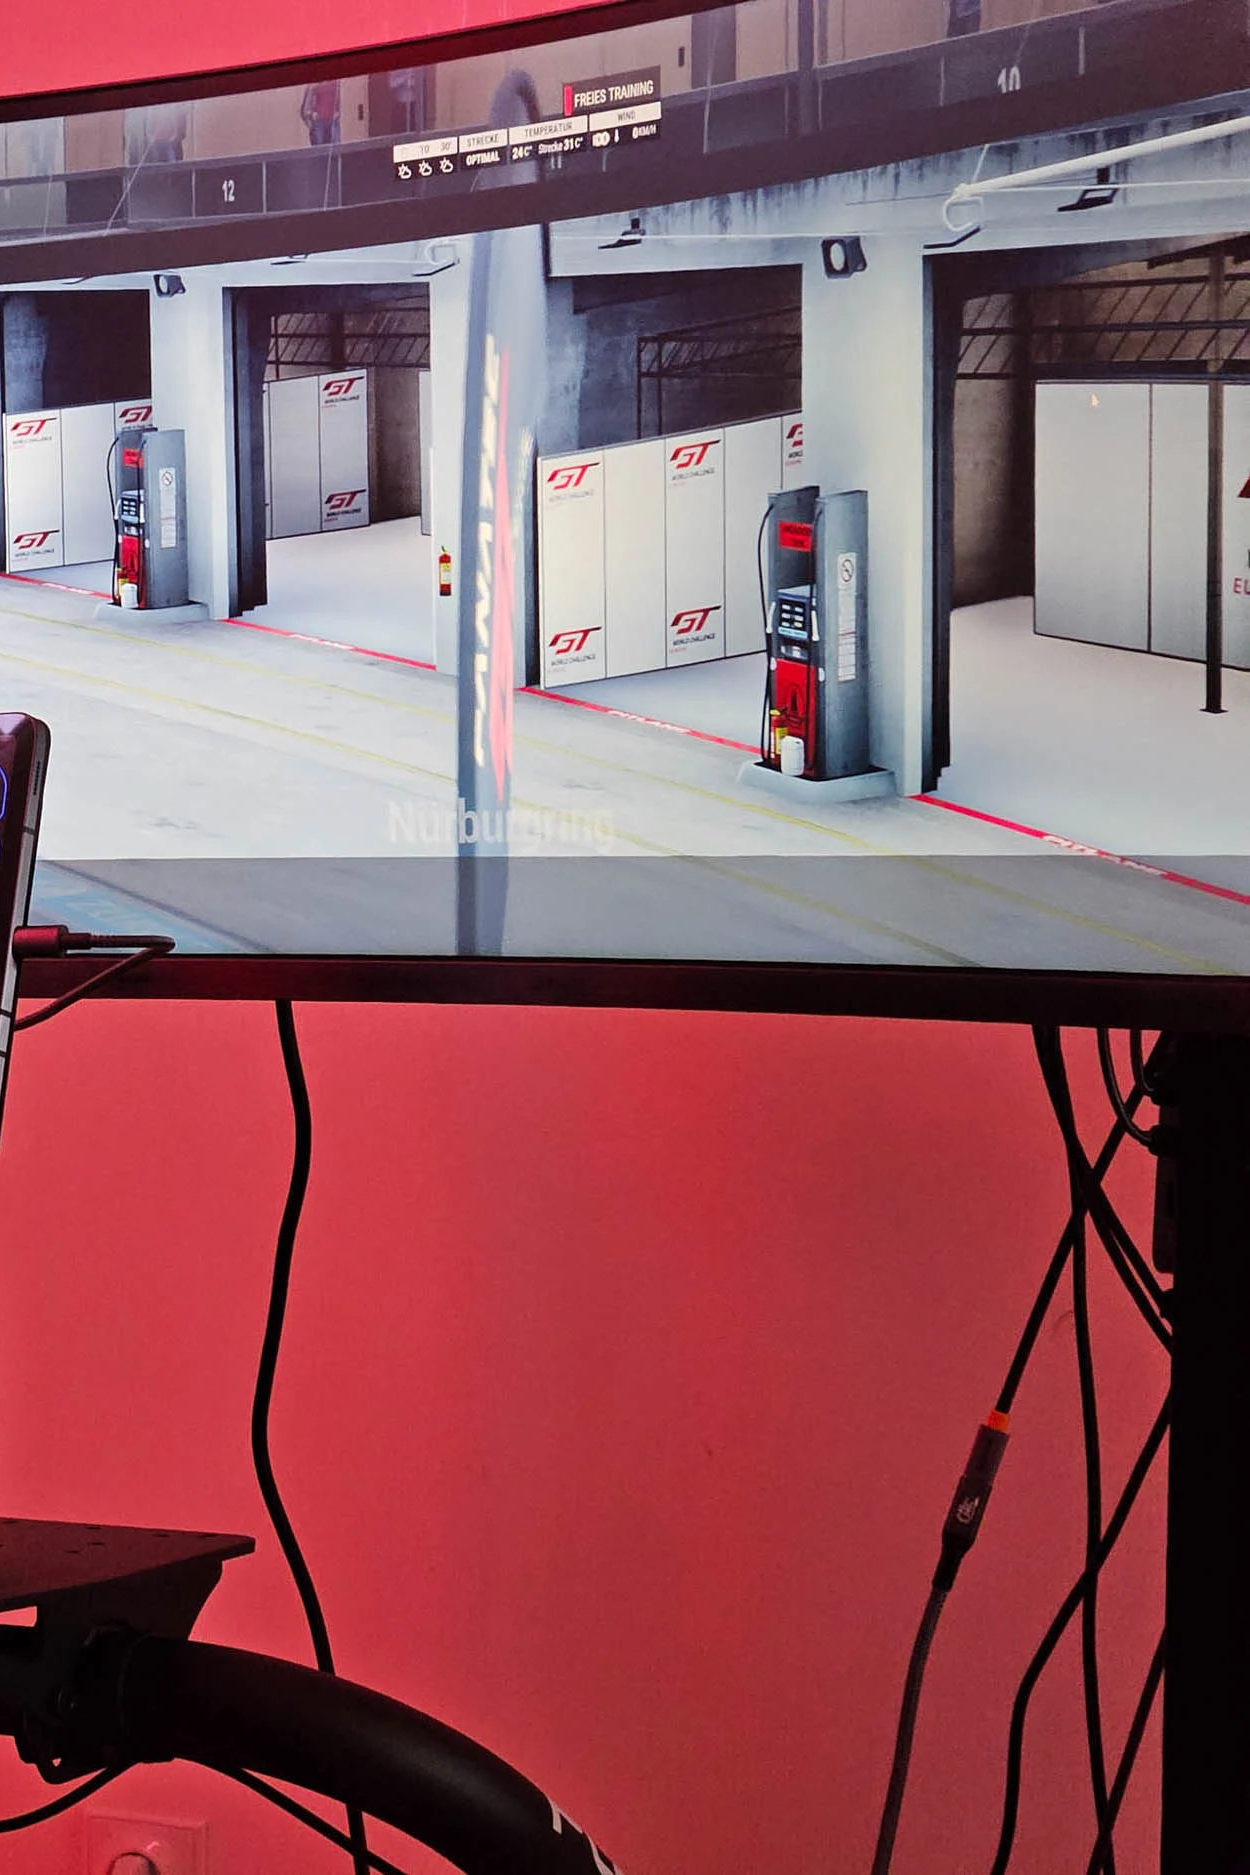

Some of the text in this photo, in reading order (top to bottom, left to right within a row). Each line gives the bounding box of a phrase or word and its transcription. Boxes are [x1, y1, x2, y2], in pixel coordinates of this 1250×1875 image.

[574, 79, 654, 109] FREIES TRAINING
[617, 110, 636, 121] WIND
[524, 122, 573, 138] TEMPERATUR
[467, 134, 500, 147] STRECKE
[466, 152, 500, 166] OPTIMAL
[222, 180, 235, 201] 12
[322, 376, 364, 396] GT
[10, 417, 57, 436] GT
[670, 440, 721, 470] GT
[547, 462, 600, 490] GT
[325, 489, 366, 510] GT
[13, 530, 60, 550] GT
[670, 605, 722, 635] GT
[548, 626, 602, 655] GT
